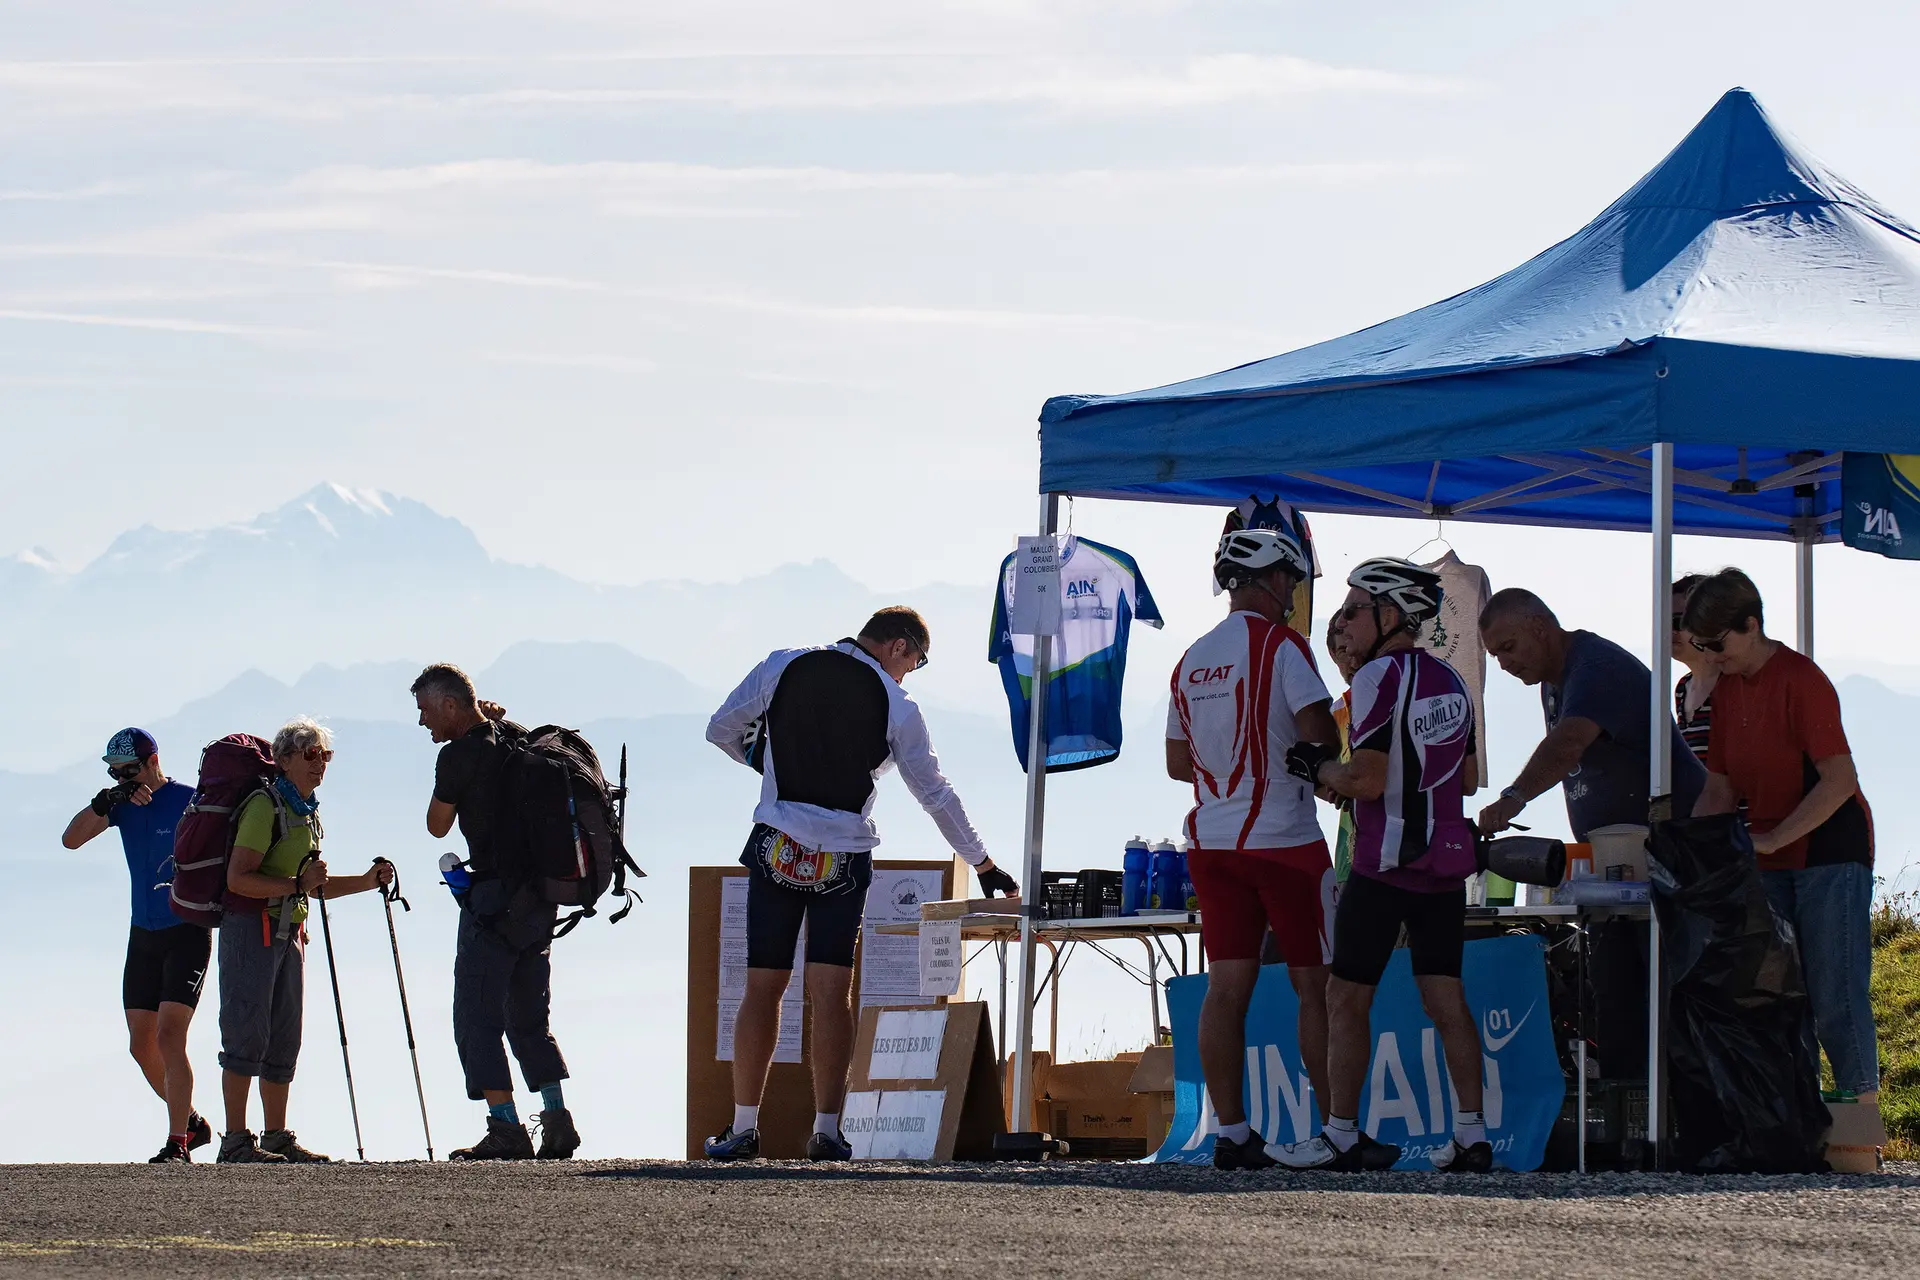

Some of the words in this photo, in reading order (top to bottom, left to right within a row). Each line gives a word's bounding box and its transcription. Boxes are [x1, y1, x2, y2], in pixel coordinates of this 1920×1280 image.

[1030, 545, 1054, 554] MAILLOT
[1032, 555, 1053, 564] GRAND
[1023, 565, 1058, 574] COLOMBIER
[1067, 580, 1095, 595] AIN
[1188, 664, 1235, 683] CIAT
[1191, 691, 1230, 702] www.ciat.com
[1414, 699, 1462, 736] RUMILLY
[934, 947, 949, 956] GRAND
[929, 959, 954, 969] COLOMBIER
[1488, 1008, 1511, 1031] 01
[873, 1038, 891, 1053] LES
[920, 1036, 935, 1052] DU
[842, 1117, 873, 1133] GRAND
[875, 1117, 926, 1133] COLOMBIER
